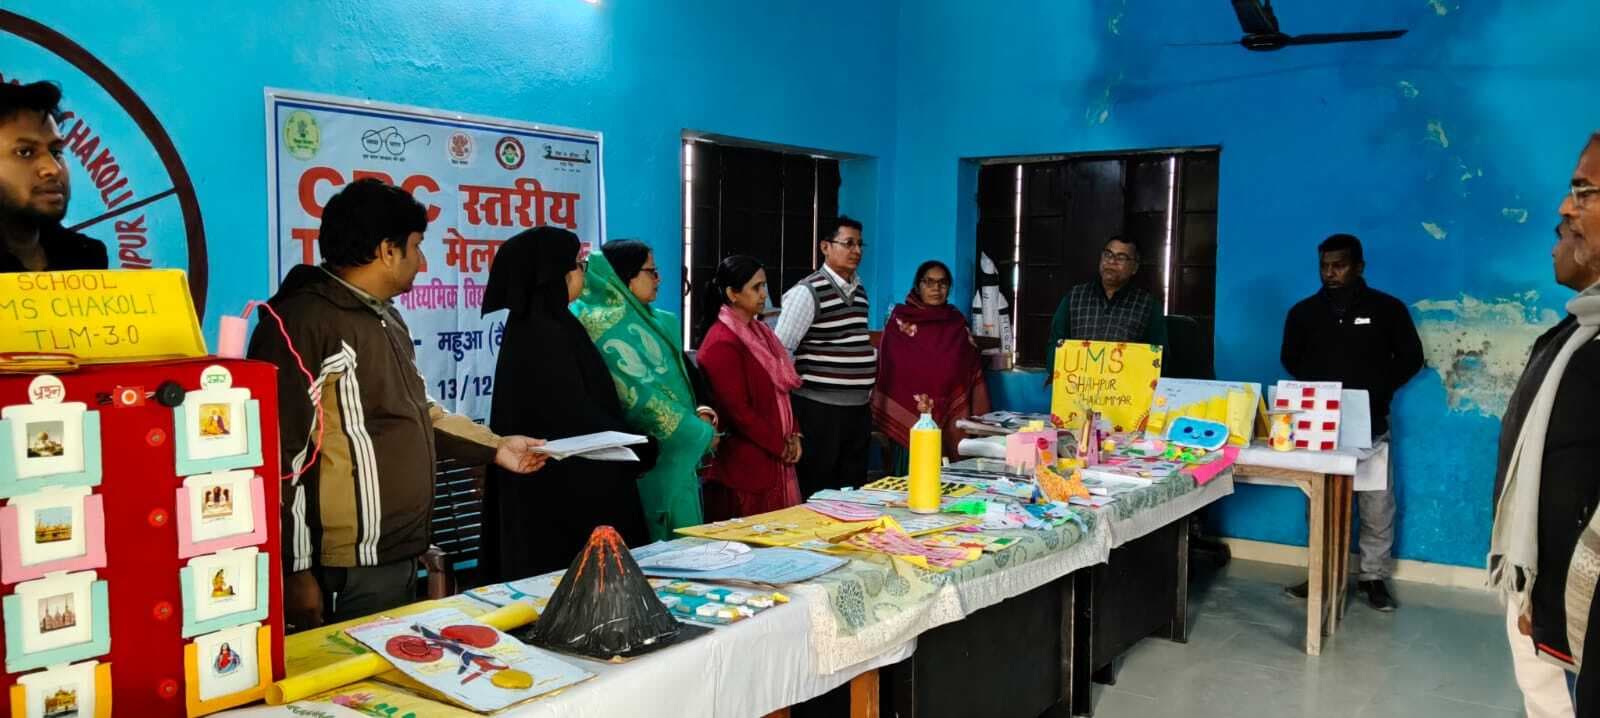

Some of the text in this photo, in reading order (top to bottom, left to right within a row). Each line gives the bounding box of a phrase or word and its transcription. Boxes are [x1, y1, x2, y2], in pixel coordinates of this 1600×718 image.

[298, 166, 580, 230] CC स्तरीय
[442, 227, 506, 273] मेल
[17, 273, 118, 291] SCHOOL
[51, 293, 157, 318] CHAKOLI
[437, 330, 483, 361] महुआ
